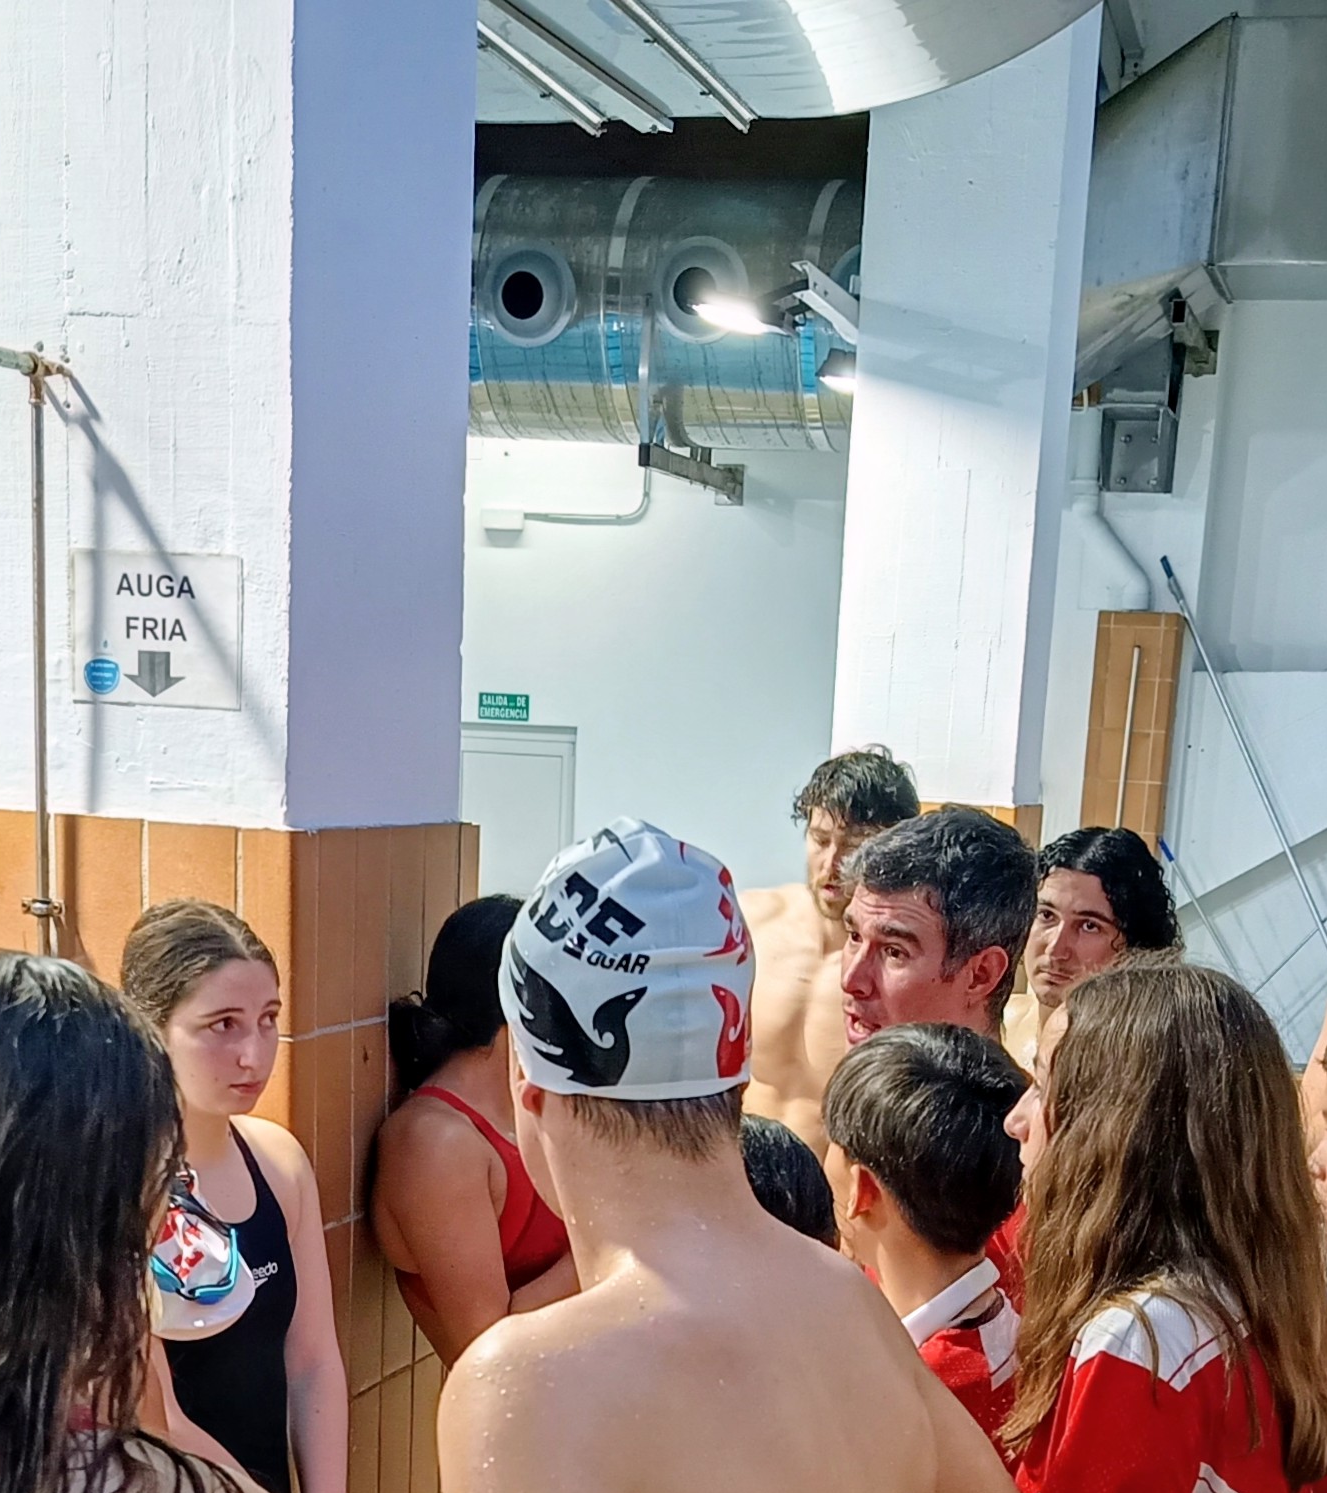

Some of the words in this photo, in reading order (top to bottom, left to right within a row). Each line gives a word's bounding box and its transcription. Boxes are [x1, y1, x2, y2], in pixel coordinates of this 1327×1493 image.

[115, 572, 196, 600] AUGA
[125, 615, 187, 642] FRIA
[482, 694, 508, 706] SALIDA
[516, 695, 527, 708] DE
[480, 706, 528, 719] EMERGENCIA
[253, 1261, 279, 1278] eedo
